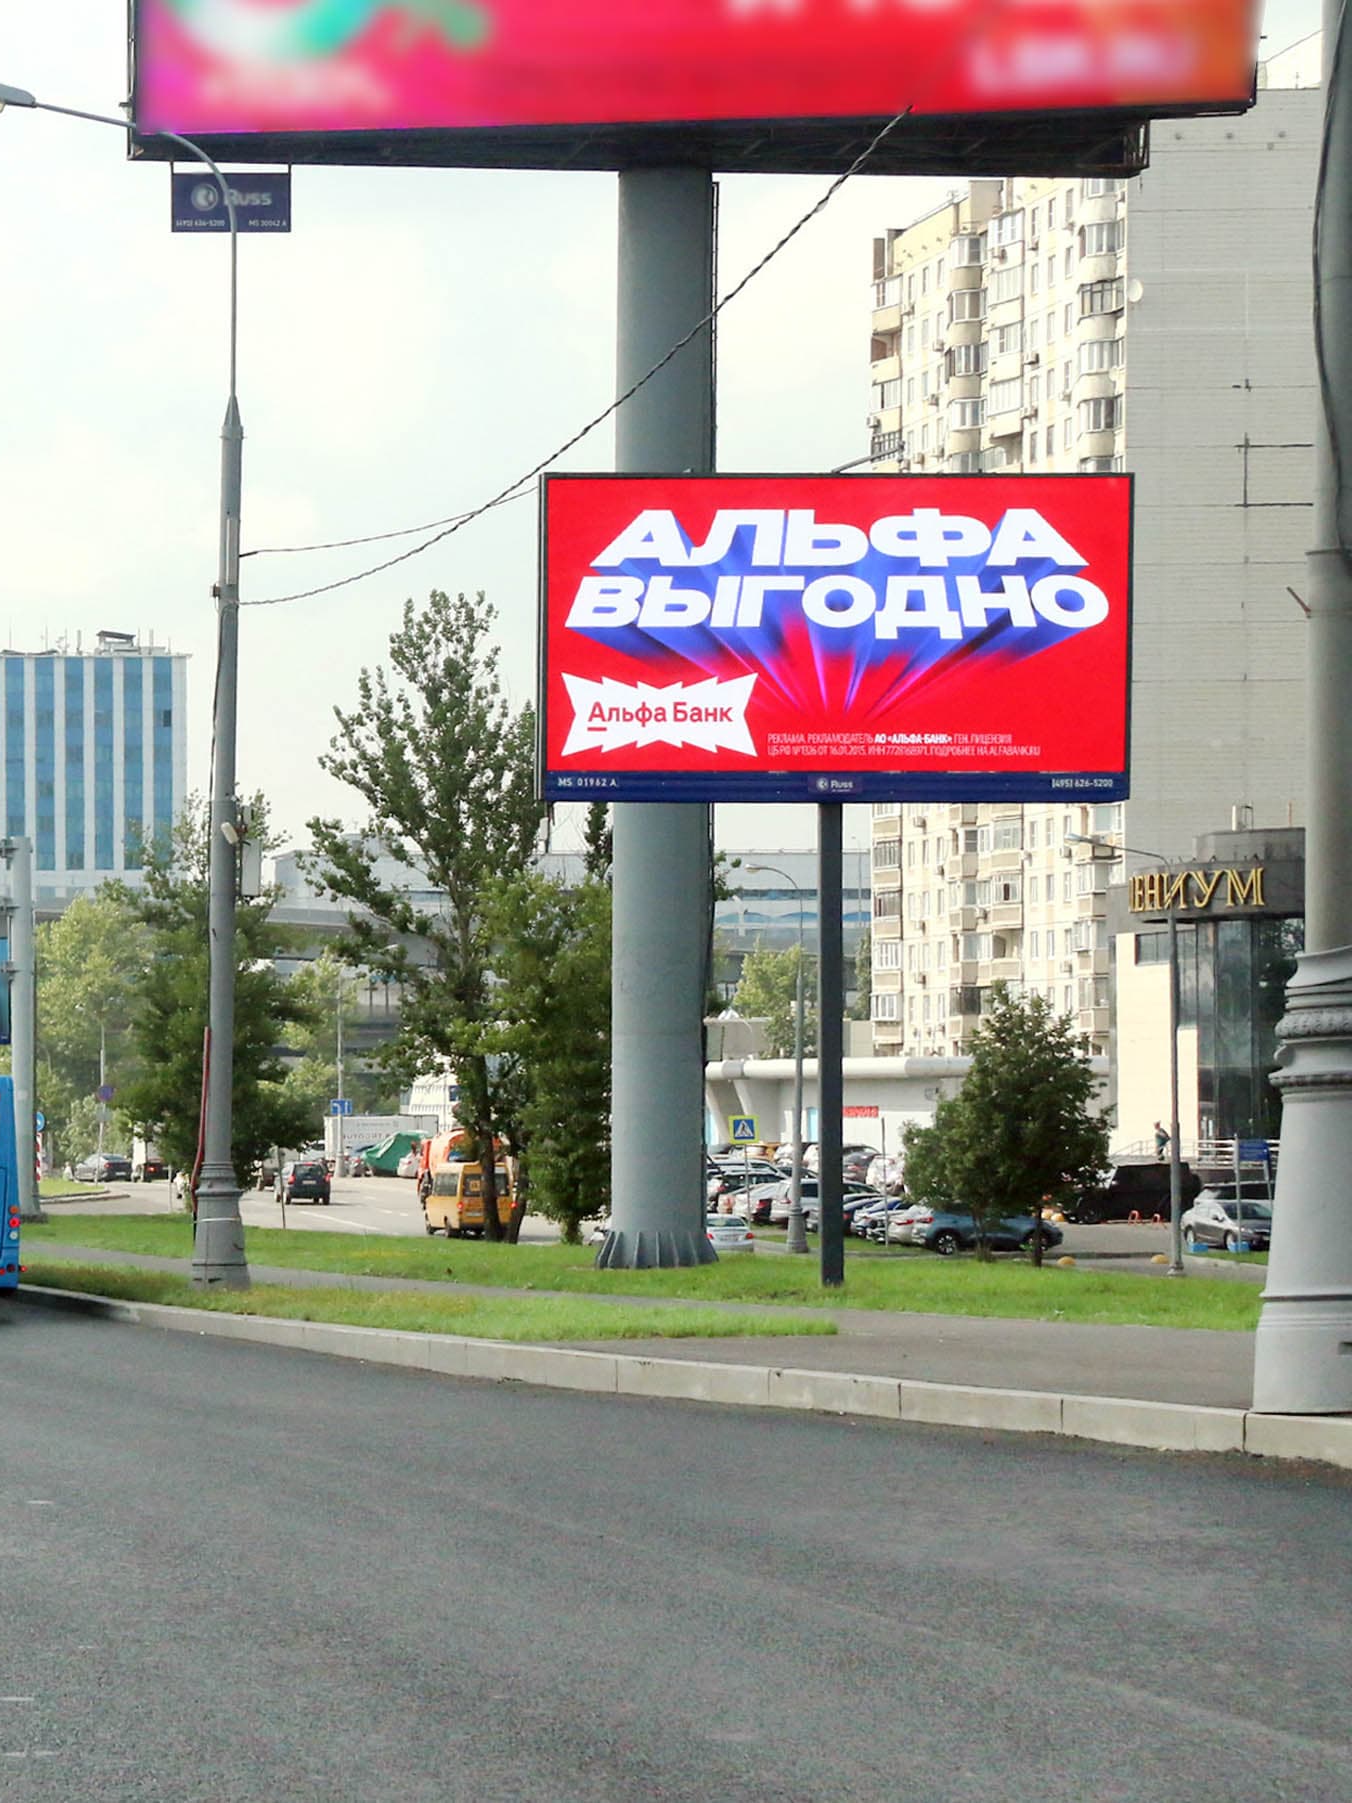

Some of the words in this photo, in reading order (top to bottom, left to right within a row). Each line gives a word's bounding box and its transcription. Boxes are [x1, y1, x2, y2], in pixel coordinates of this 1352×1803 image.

[590, 508, 1090, 567] АЛЬФА
[564, 575, 1110, 639] ВЫГОДНО
[587, 701, 667, 729] Альфа
[673, 701, 733, 722] Банк
[874, 733, 886, 744] АО
[557, 777, 572, 787] MS
[610, 778, 617, 787] A
